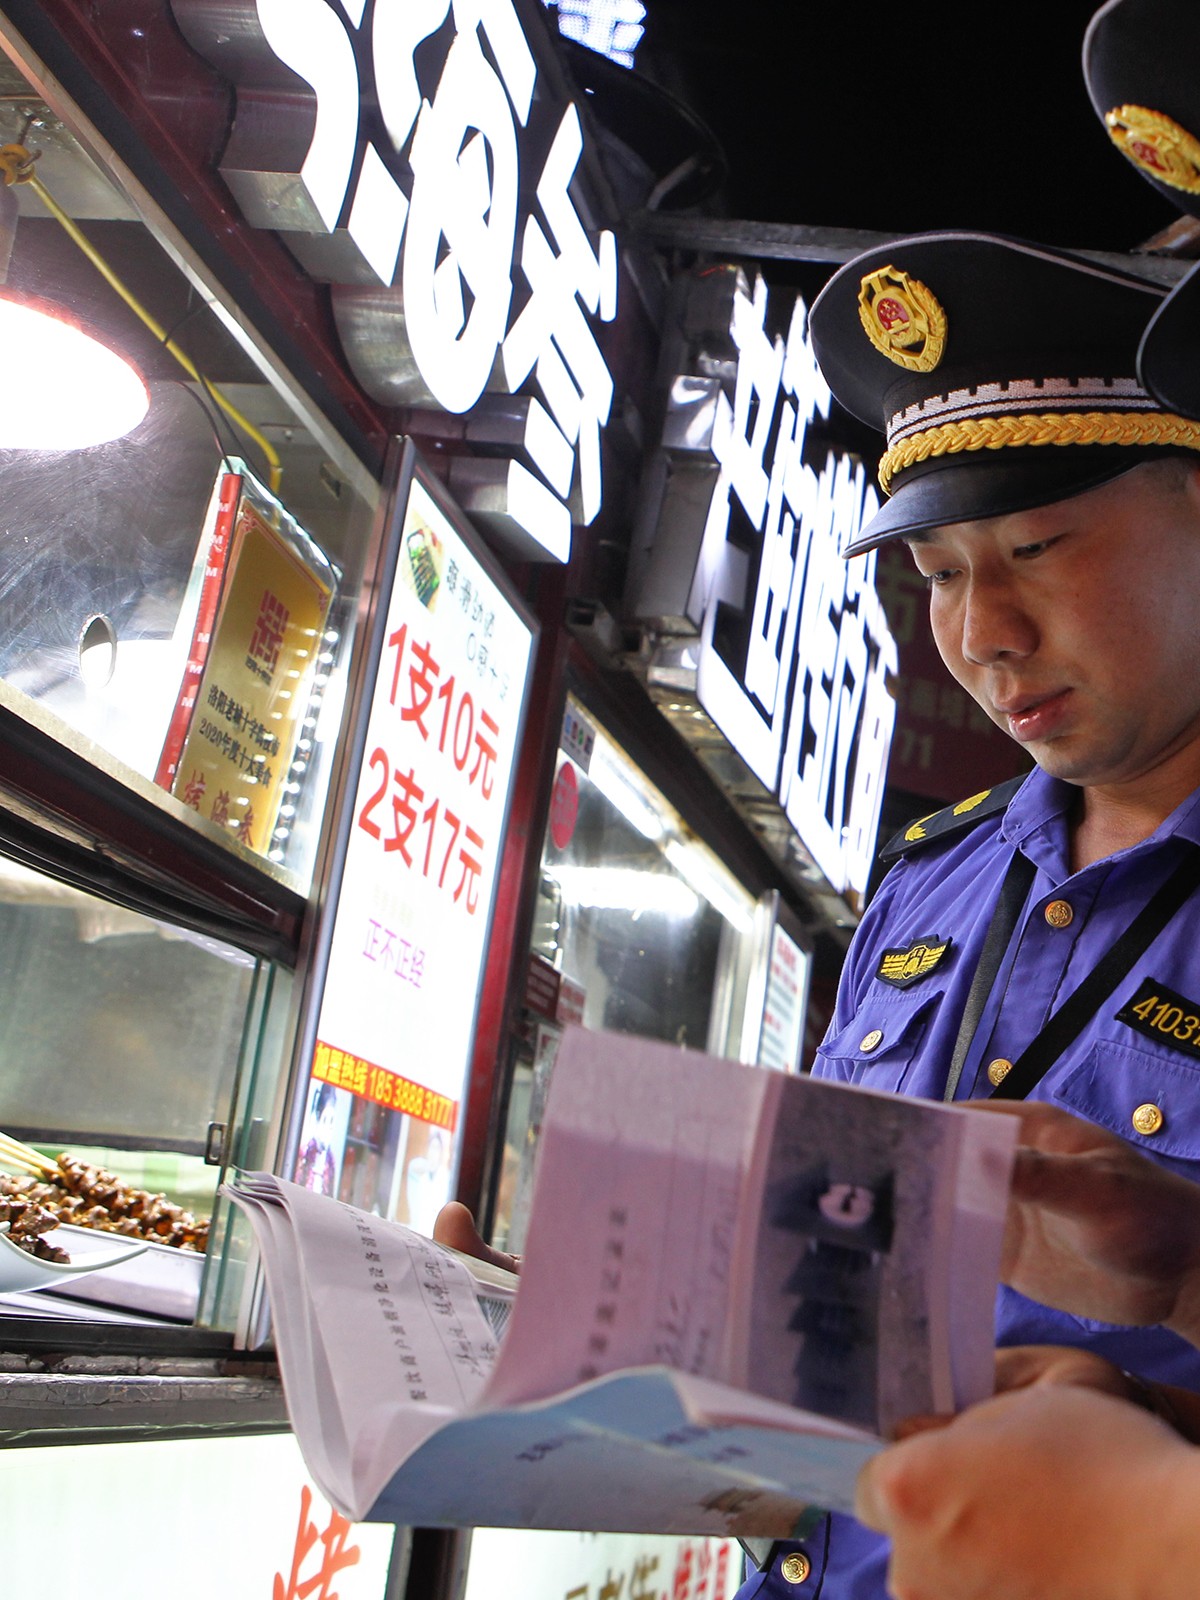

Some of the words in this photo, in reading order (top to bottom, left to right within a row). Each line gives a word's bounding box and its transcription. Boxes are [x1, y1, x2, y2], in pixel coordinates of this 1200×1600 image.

[388, 623, 500, 800] 1支10元
[358, 746, 485, 915] 2支17元
[370, 1068, 393, 1102] 185
[394, 1079, 424, 1115] 3888
